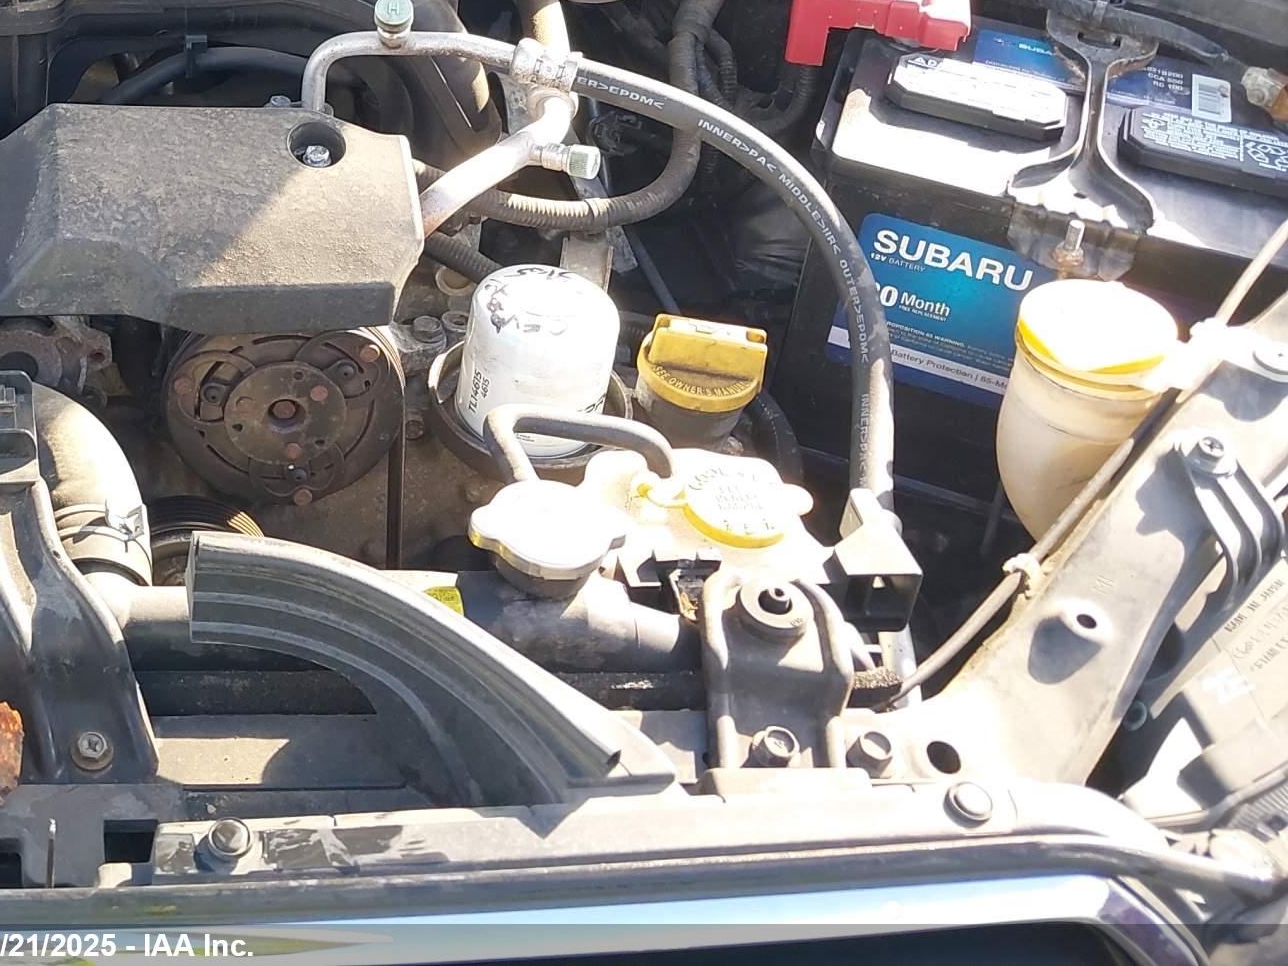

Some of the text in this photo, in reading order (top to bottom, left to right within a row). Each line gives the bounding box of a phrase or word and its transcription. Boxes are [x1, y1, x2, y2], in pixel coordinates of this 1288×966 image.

[387, 1, 400, 15] H
[1018, 43, 1053, 56] SUBA
[870, 251, 926, 273] 12V BATTERY
[874, 229, 1034, 291] SUBARU
[900, 292, 951, 318] Month
[926, 359, 974, 379] Protection
[467, 370, 483, 414] TL14615
[481, 378, 491, 399] 4615
[652, 365, 670, 381] SEE
[713, 380, 752, 397] MANUAL
